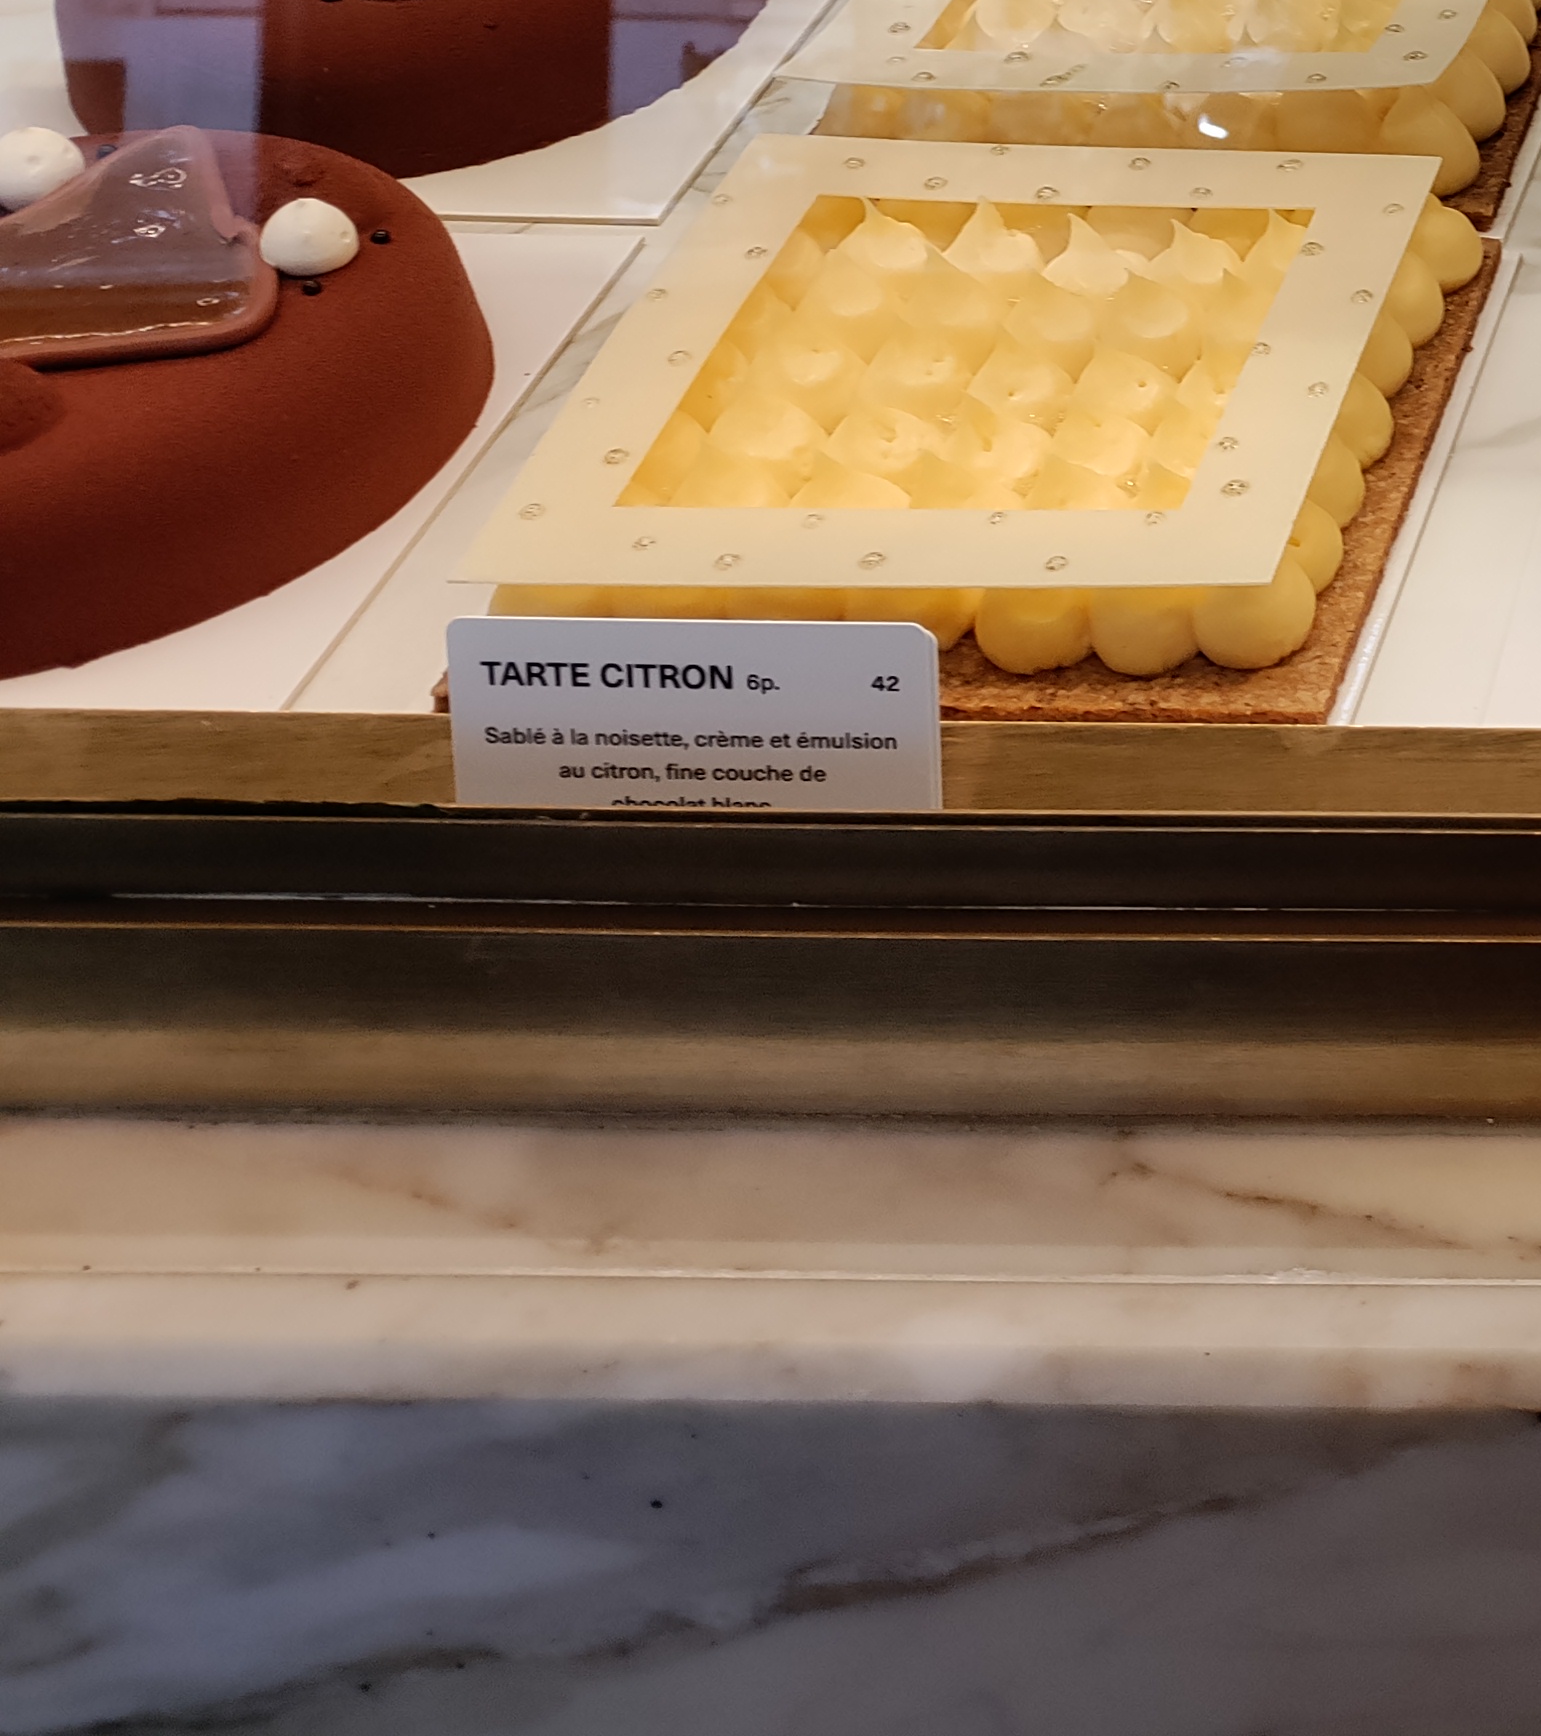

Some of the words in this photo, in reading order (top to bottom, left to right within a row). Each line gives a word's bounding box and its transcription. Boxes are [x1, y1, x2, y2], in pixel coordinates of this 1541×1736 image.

[480, 662, 590, 687] TARTE
[601, 663, 733, 689] CITRON
[747, 674, 780, 694] 6p.
[871, 676, 899, 691] 42
[485, 727, 546, 744] Sablé
[552, 728, 564, 744] à
[571, 729, 589, 745] la
[595, 730, 689, 750] noisette,
[694, 731, 763, 748] crème
[770, 734, 791, 748] et
[797, 732, 897, 749] émulsion
[559, 766, 585, 778] au
[591, 763, 660, 782] citron,
[665, 764, 706, 780] fine
[712, 765, 793, 781] couche
[800, 766, 826, 782] de
